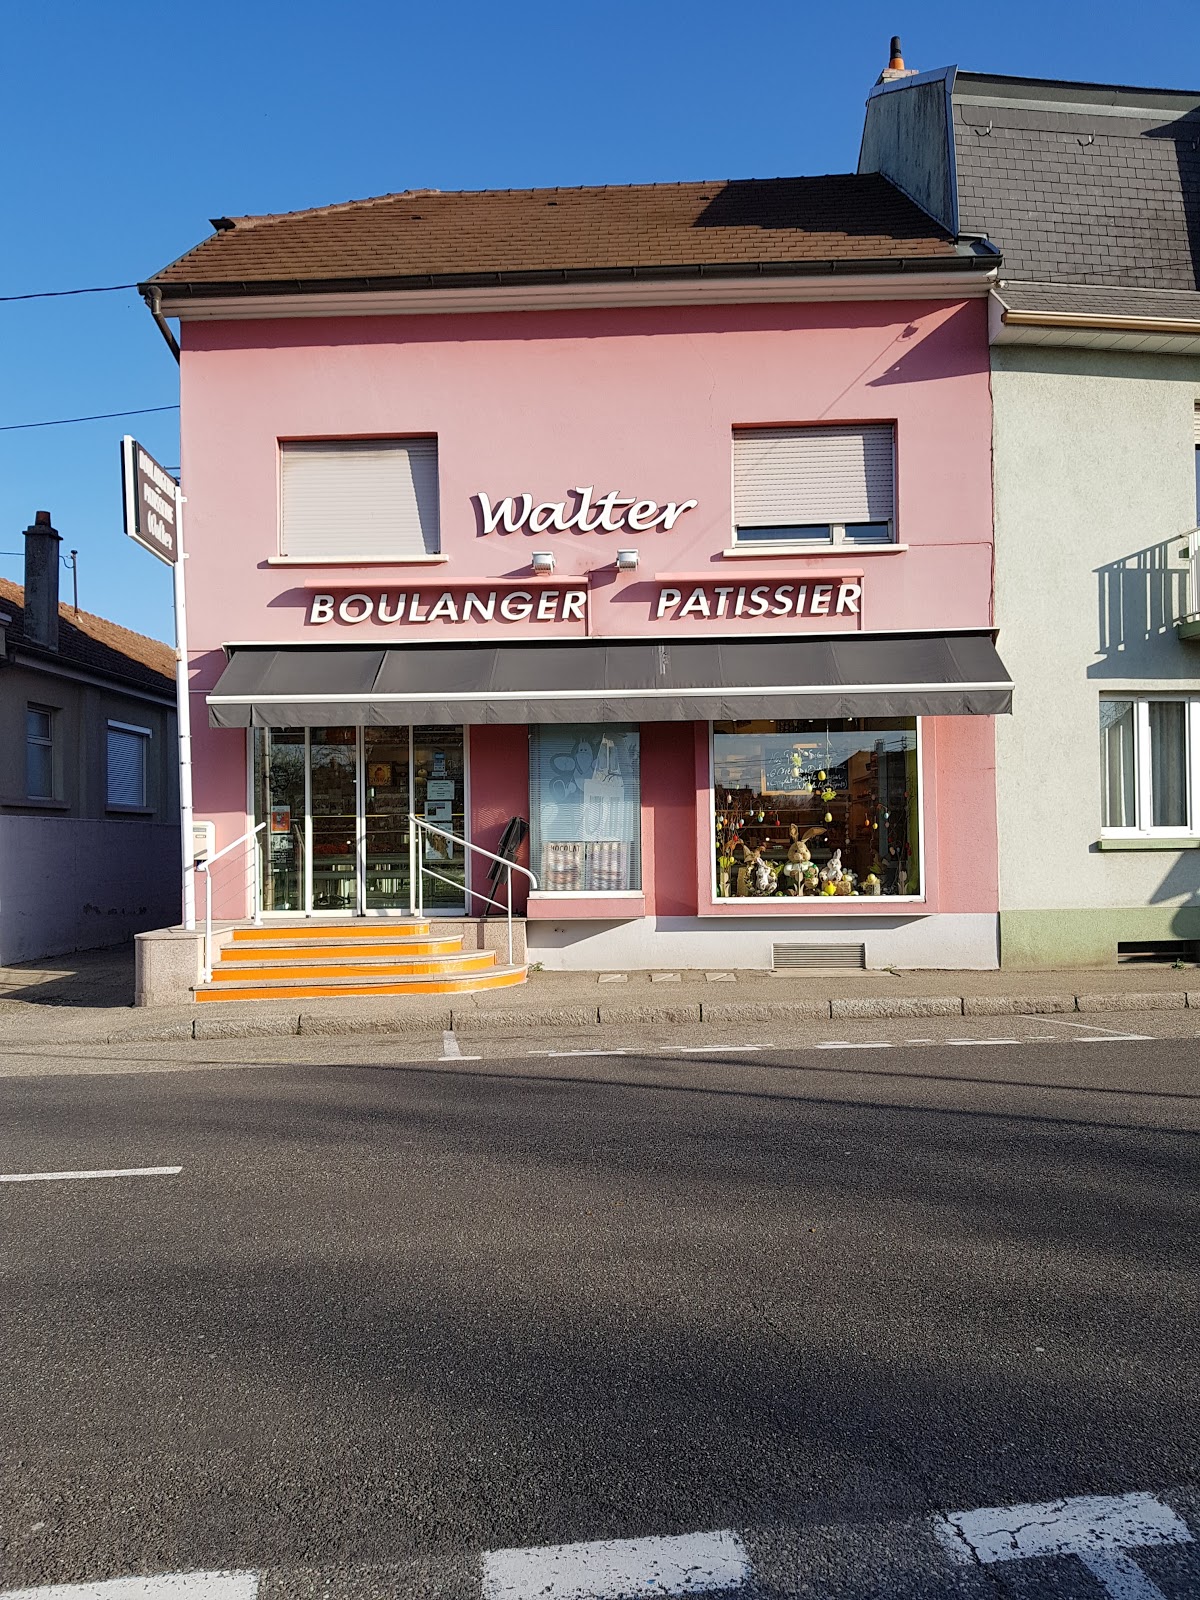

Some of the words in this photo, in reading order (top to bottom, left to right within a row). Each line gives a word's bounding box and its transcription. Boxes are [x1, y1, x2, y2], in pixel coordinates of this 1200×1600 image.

[476, 486, 698, 534] Walter
[310, 591, 587, 623] BOULANGER
[657, 582, 862, 618] PATISSIER
